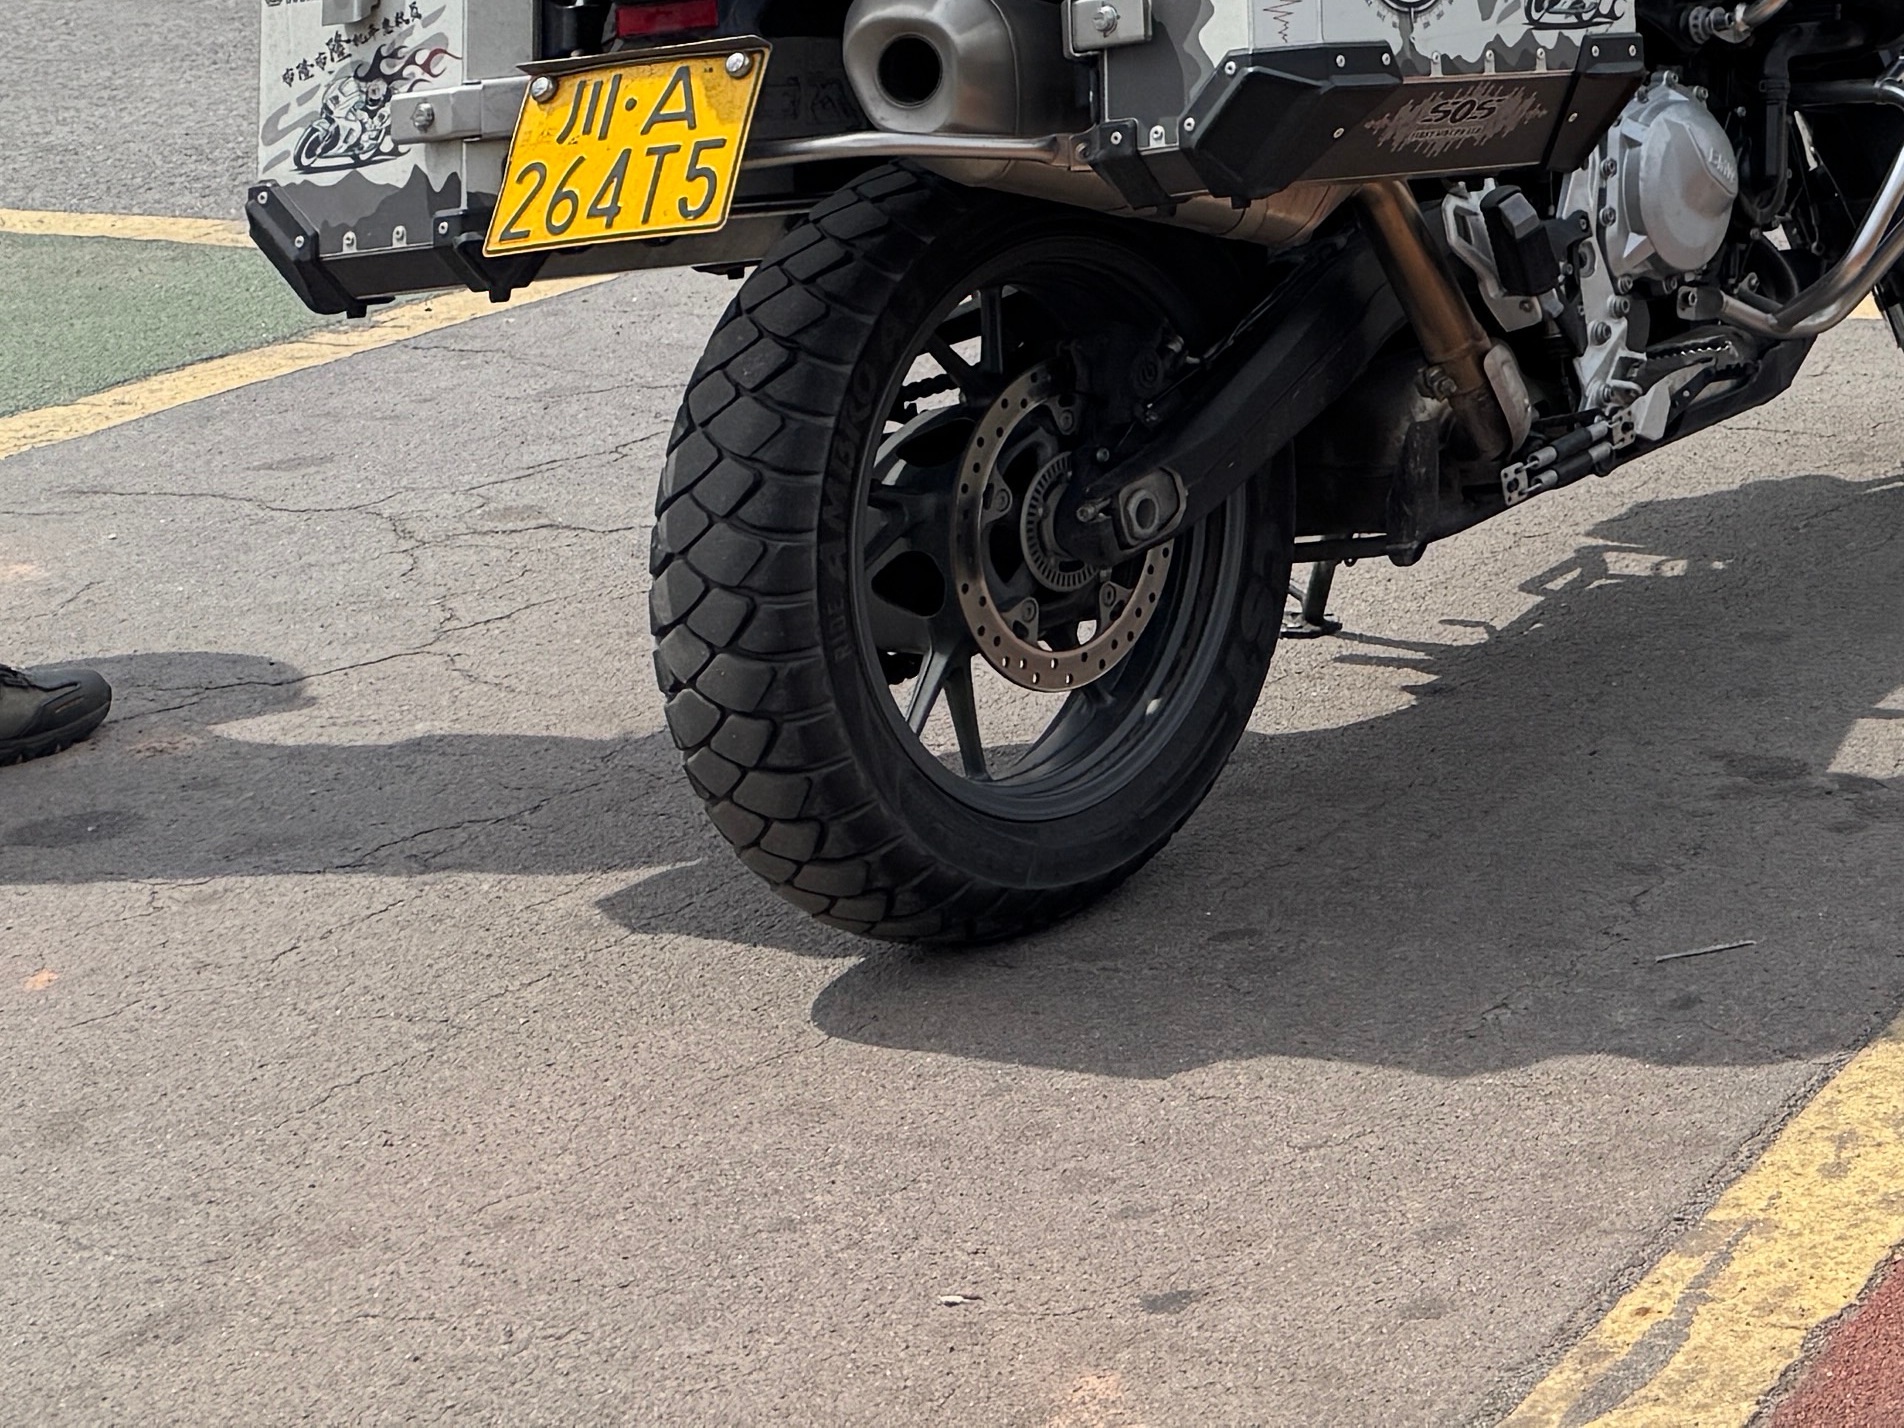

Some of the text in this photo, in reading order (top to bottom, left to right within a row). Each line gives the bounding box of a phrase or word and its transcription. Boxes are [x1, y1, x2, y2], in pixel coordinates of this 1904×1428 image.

[556, 65, 697, 144] 川·A
[1420, 97, 1507, 124] SOS
[500, 138, 727, 241] 264T5
